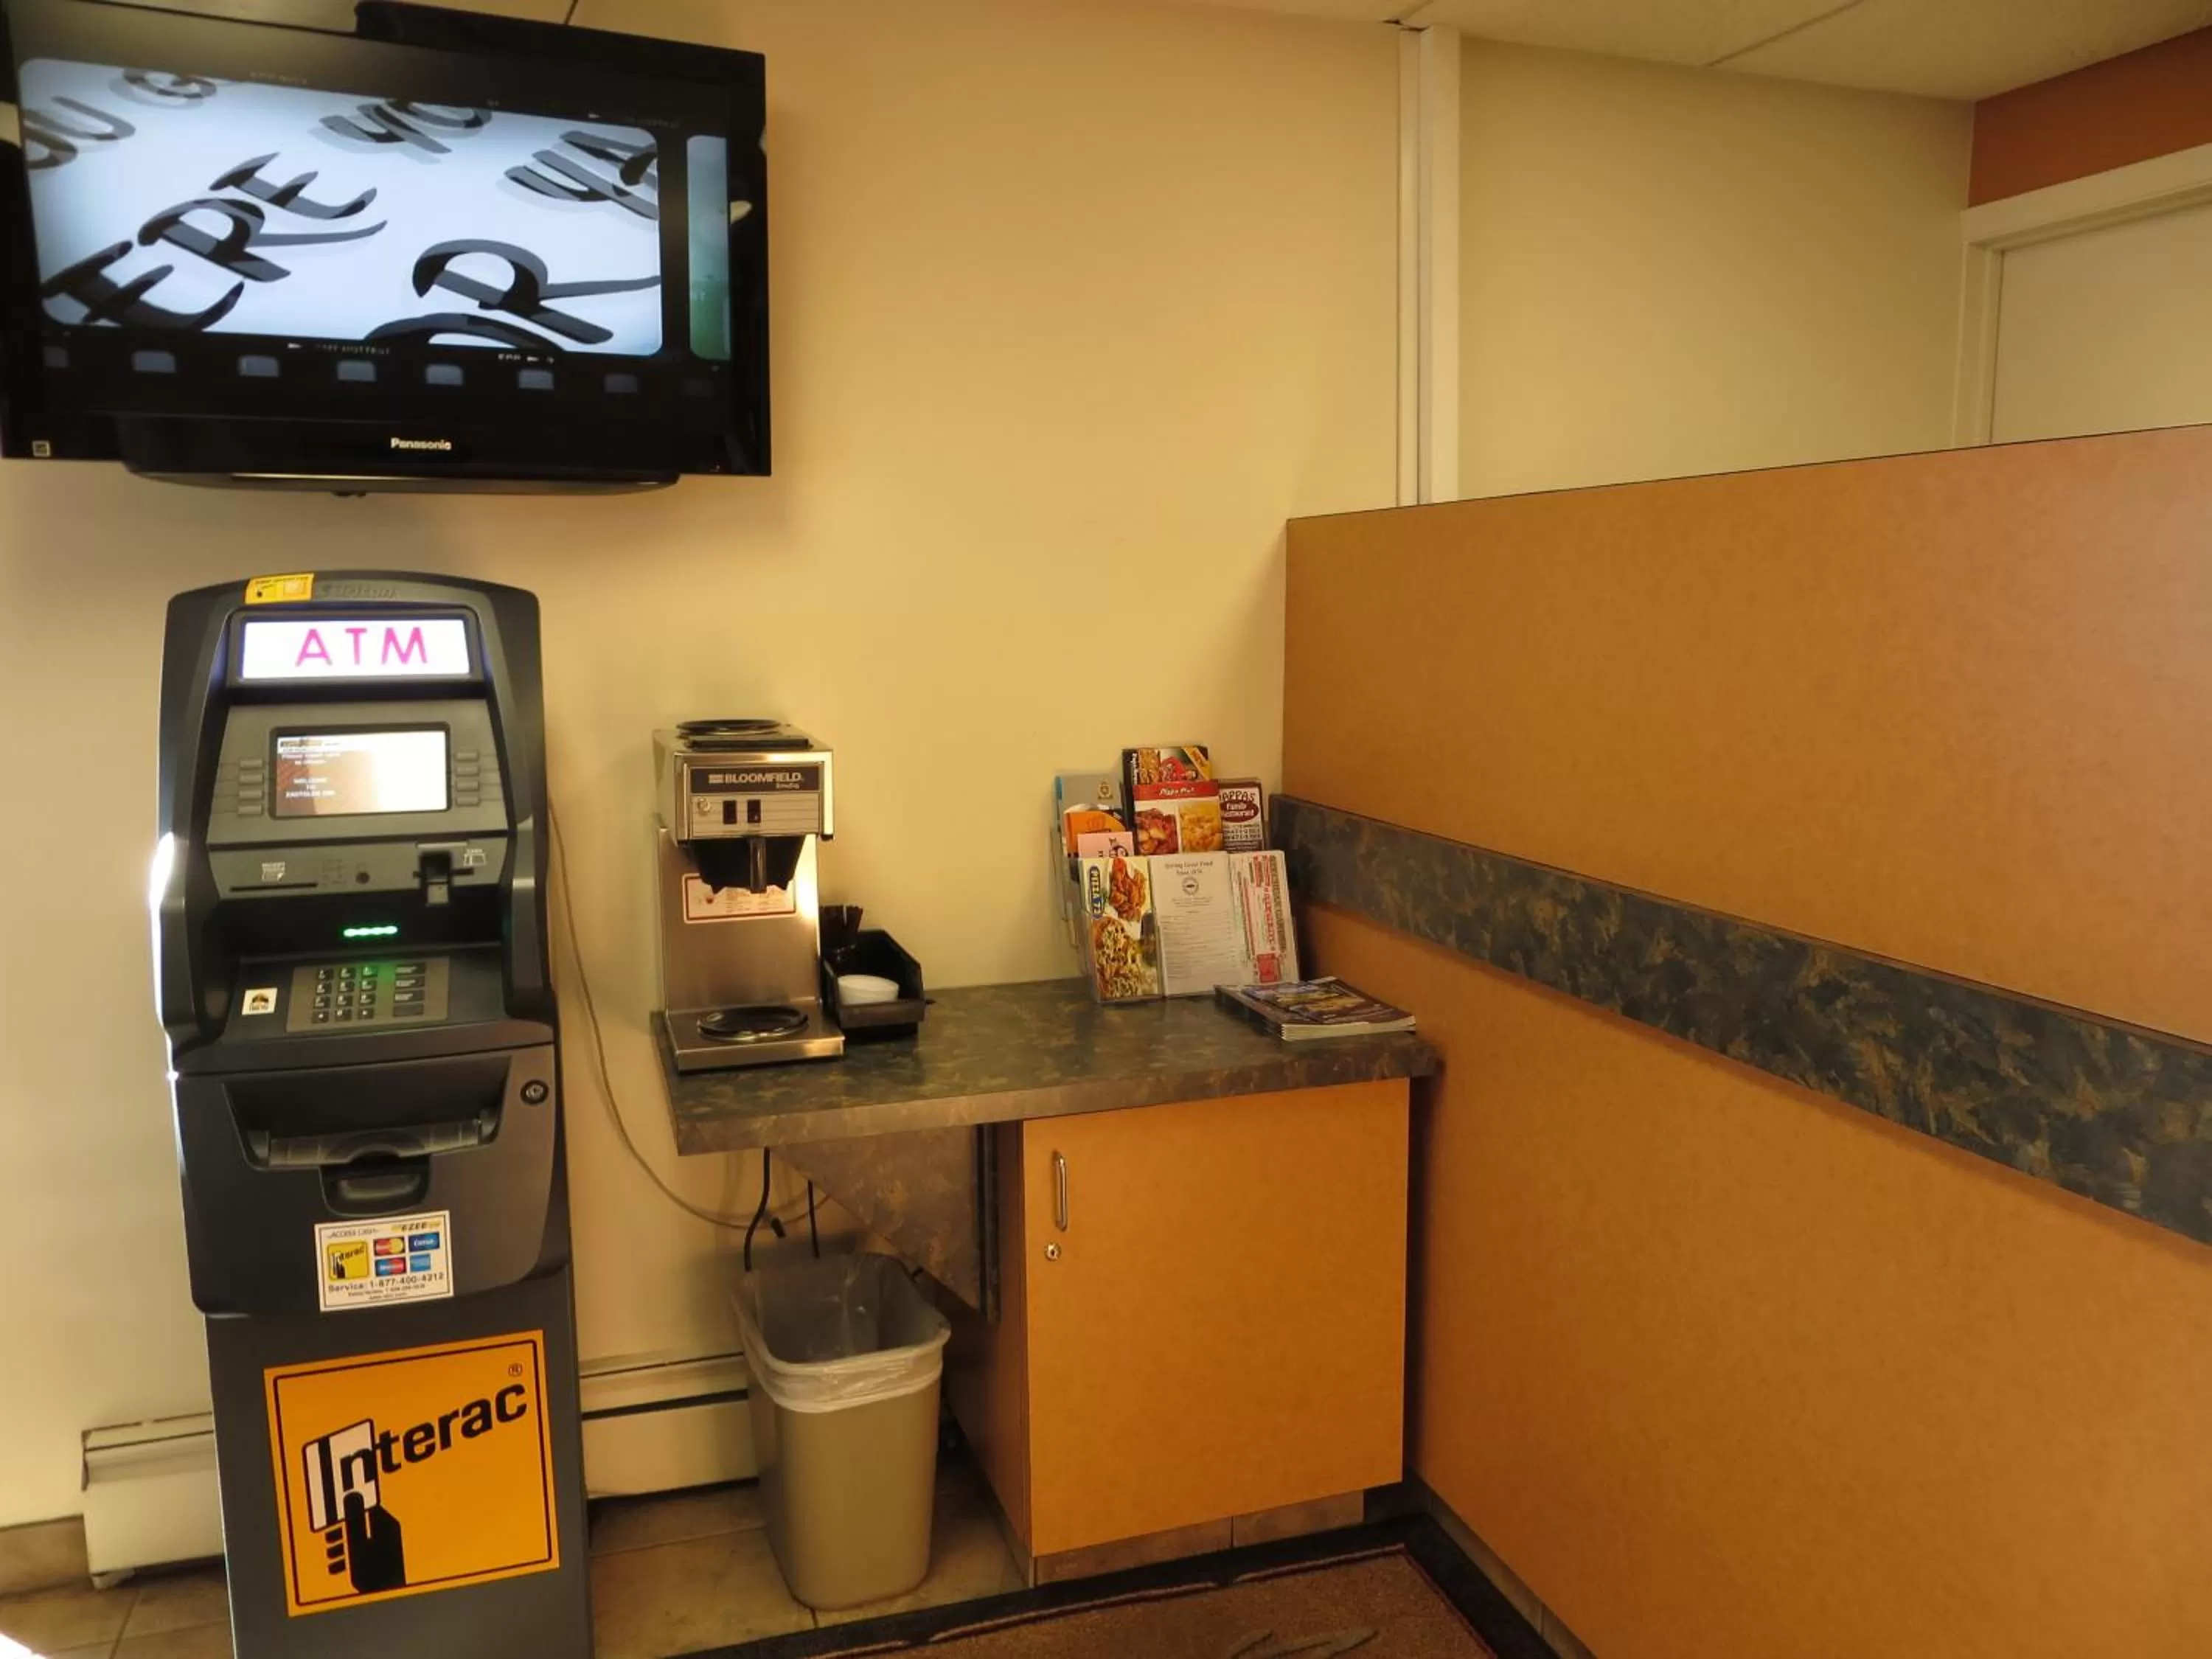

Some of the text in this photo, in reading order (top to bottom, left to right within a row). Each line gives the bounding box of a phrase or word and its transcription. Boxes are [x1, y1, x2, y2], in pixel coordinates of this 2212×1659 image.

[391, 438, 451, 451] Panasonic
[296, 626, 428, 667] ATM
[726, 772, 802, 785] BLOOMFIELD
[318, 1382, 528, 1526] Interac
